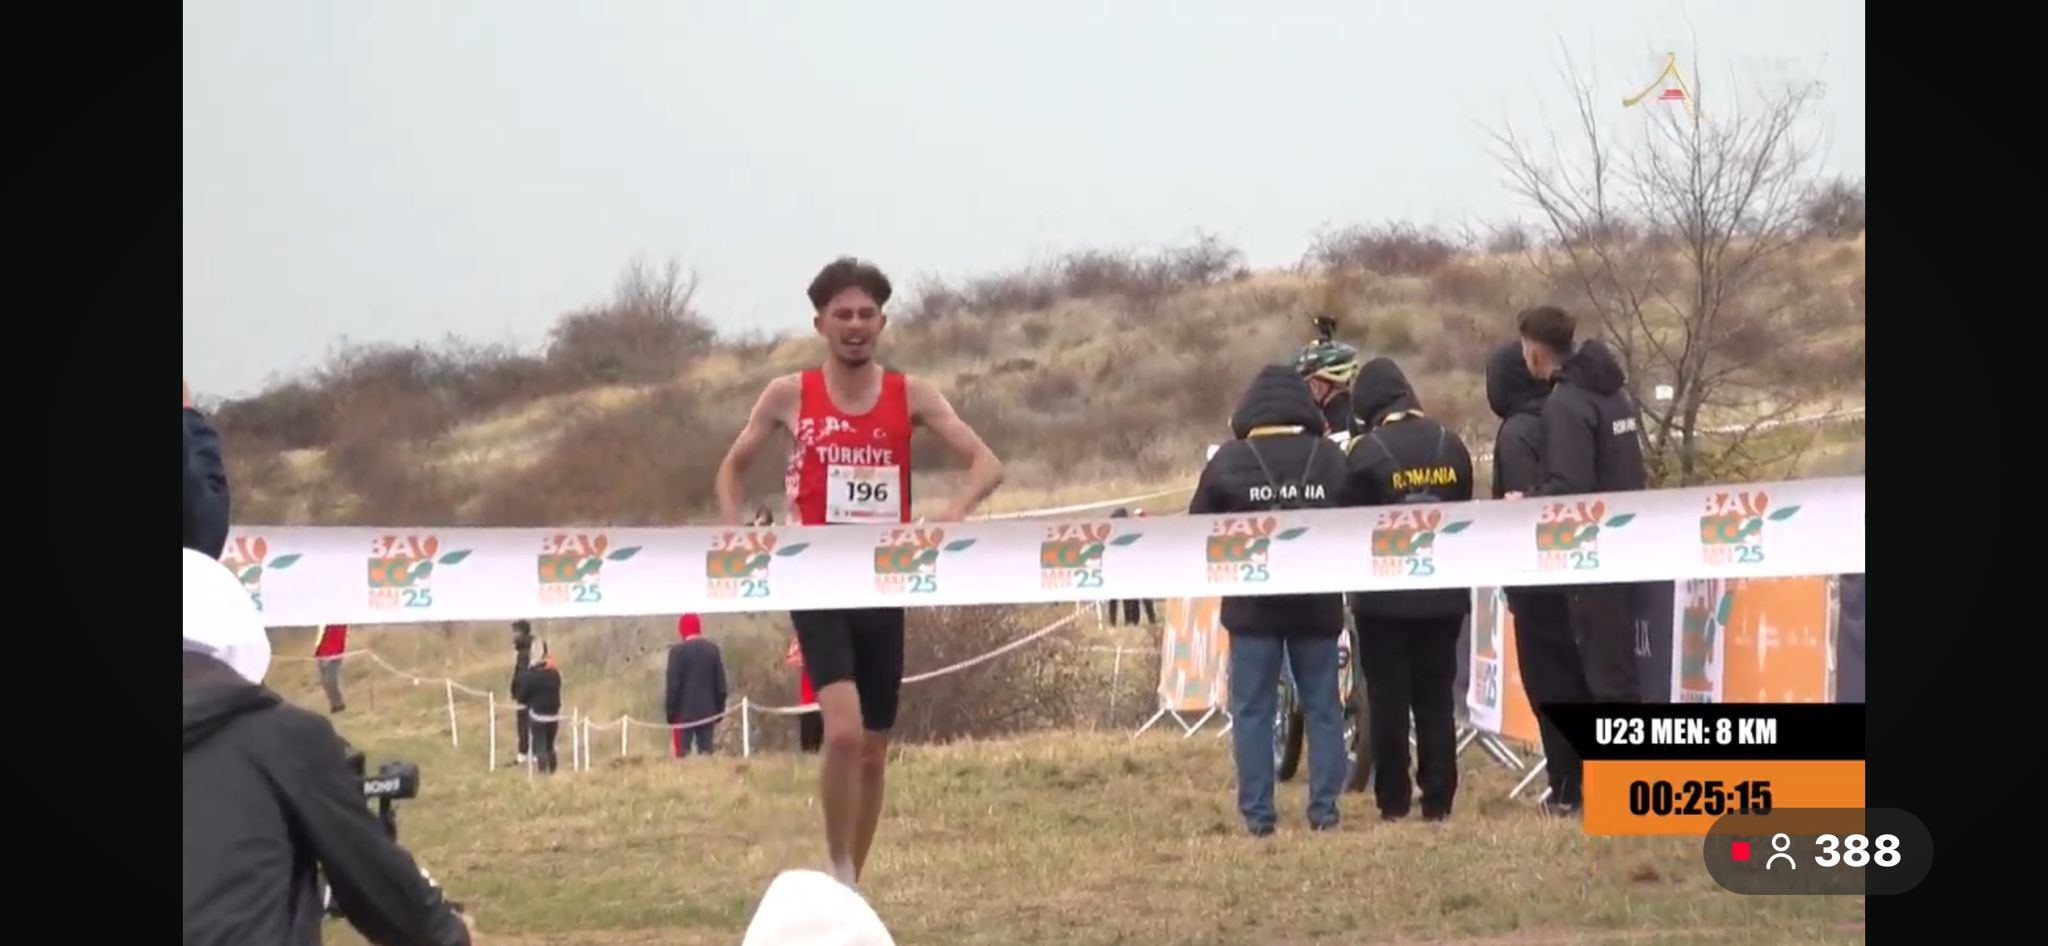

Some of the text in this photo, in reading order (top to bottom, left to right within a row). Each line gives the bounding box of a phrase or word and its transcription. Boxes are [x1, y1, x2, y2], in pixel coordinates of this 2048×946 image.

[816, 443, 892, 465] TÜRKİYE
[846, 481, 888, 502] 196
[1570, 551, 1600, 570] 25
[1734, 544, 1764, 564] 25
[1240, 563, 1269, 583] 25
[1405, 557, 1435, 576] 25
[908, 574, 938, 593] 25
[1074, 569, 1104, 588] 25
[401, 588, 432, 608] 25
[572, 584, 602, 603] 25
[740, 579, 770, 598] 25
